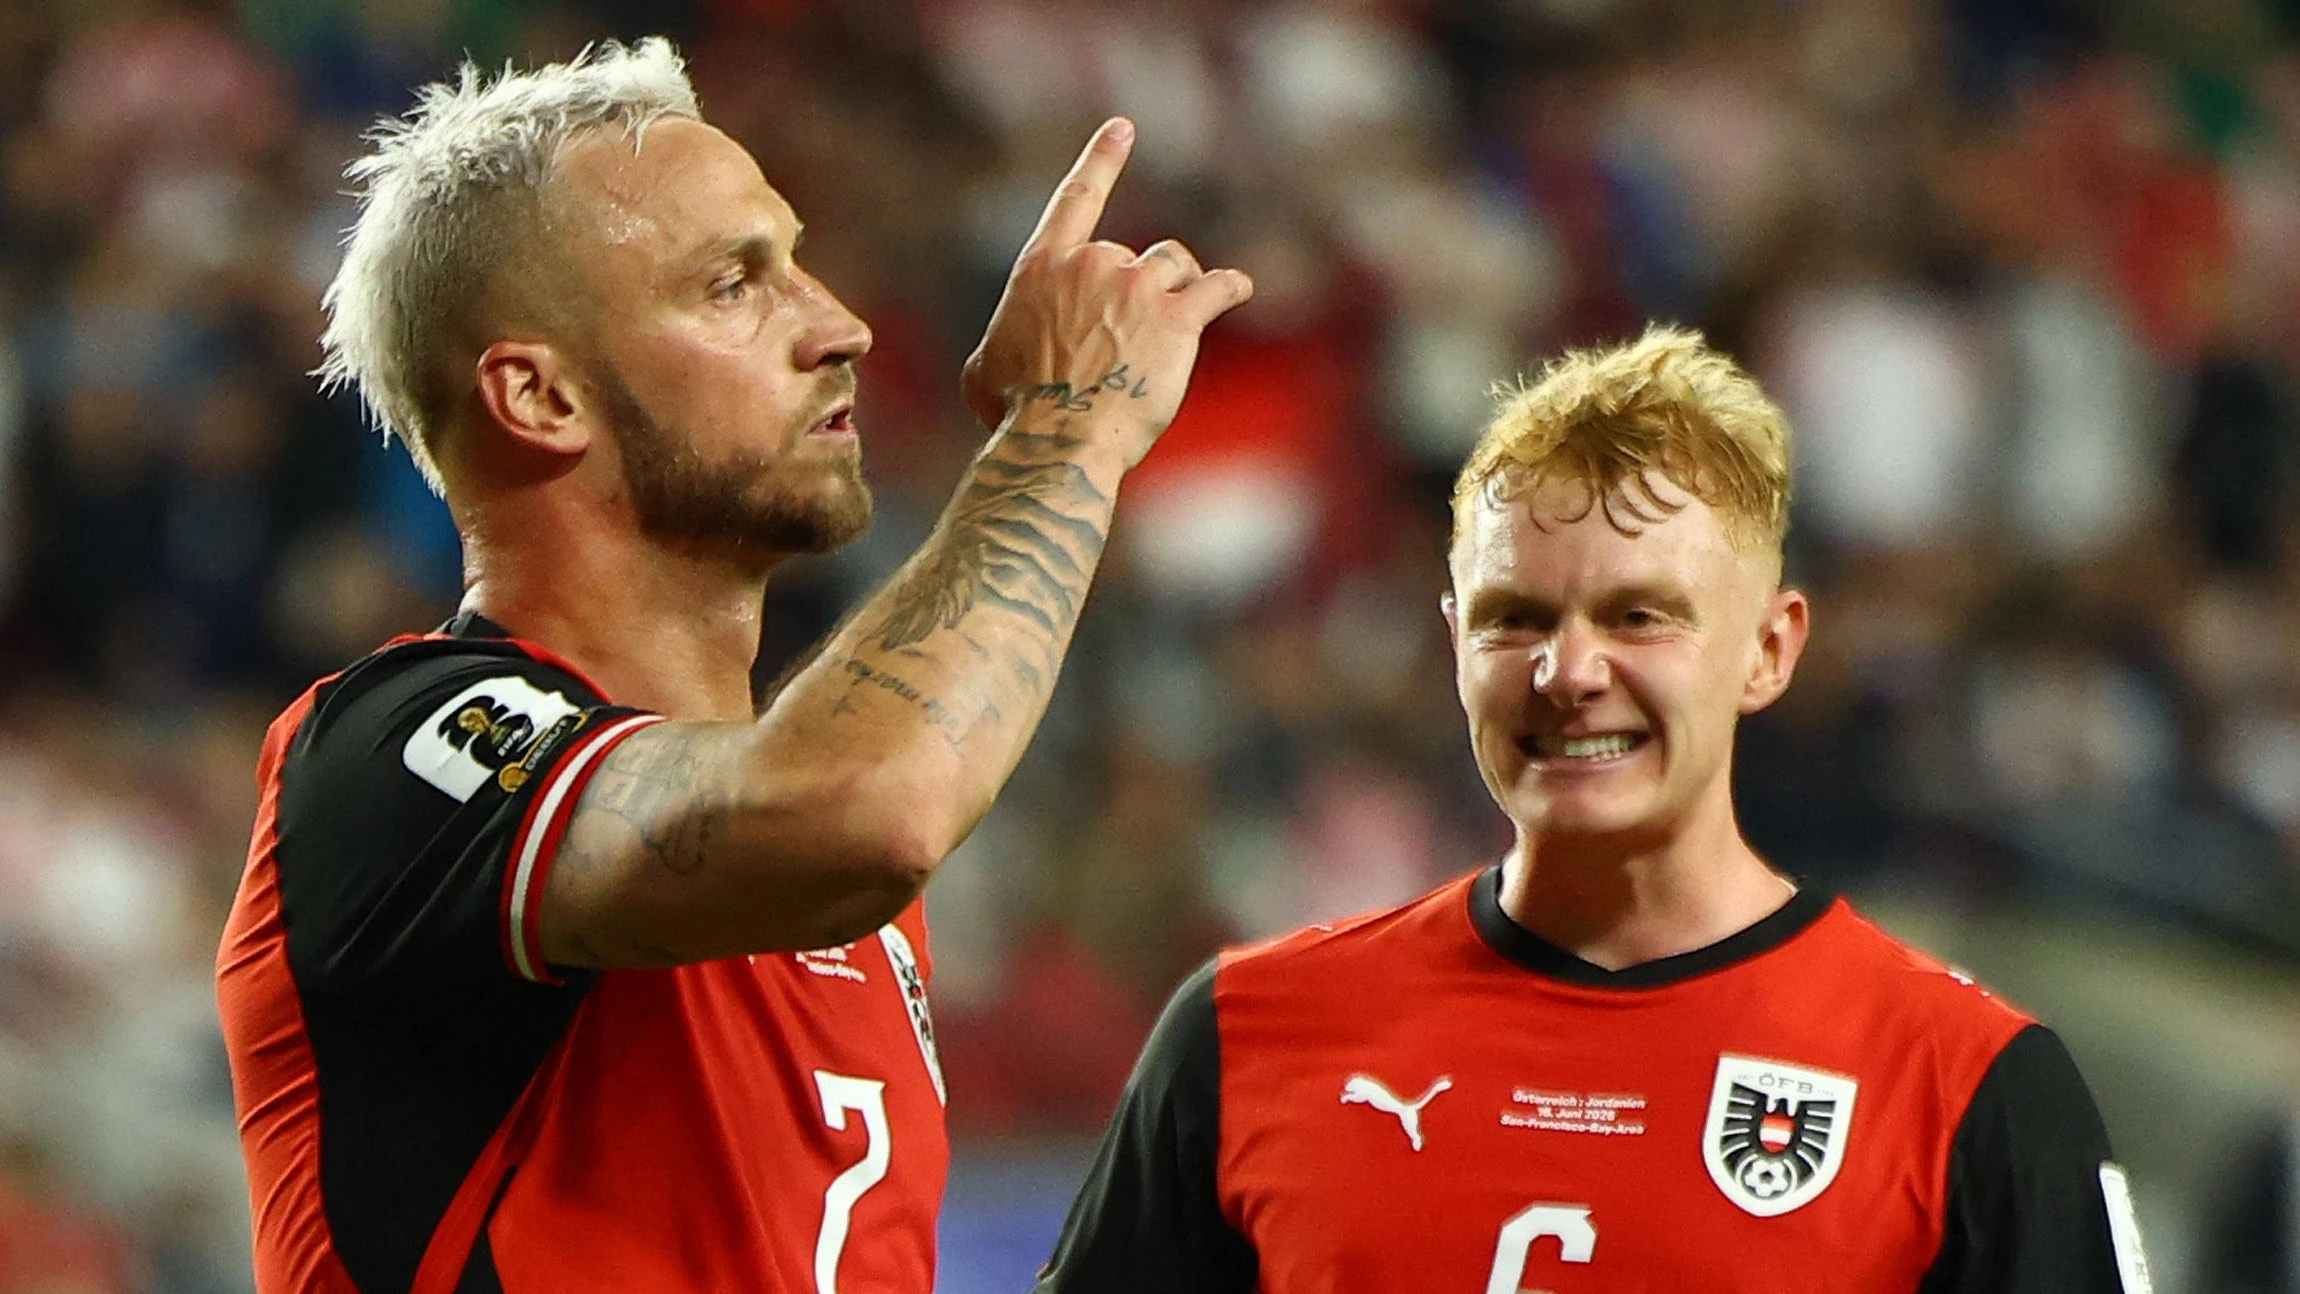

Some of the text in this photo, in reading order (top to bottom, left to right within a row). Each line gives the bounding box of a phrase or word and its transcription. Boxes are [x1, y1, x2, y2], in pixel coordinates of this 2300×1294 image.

[1758, 1072, 1813, 1095] ÖFB
[1512, 1089, 1577, 1107] Österreich
[1585, 1097, 1646, 1109] Jordanien
[1556, 1108, 1582, 1119] Juni
[1500, 1115, 1645, 1136] San-Francisco-Bay-Area
[813, 1069, 892, 1294] 7
